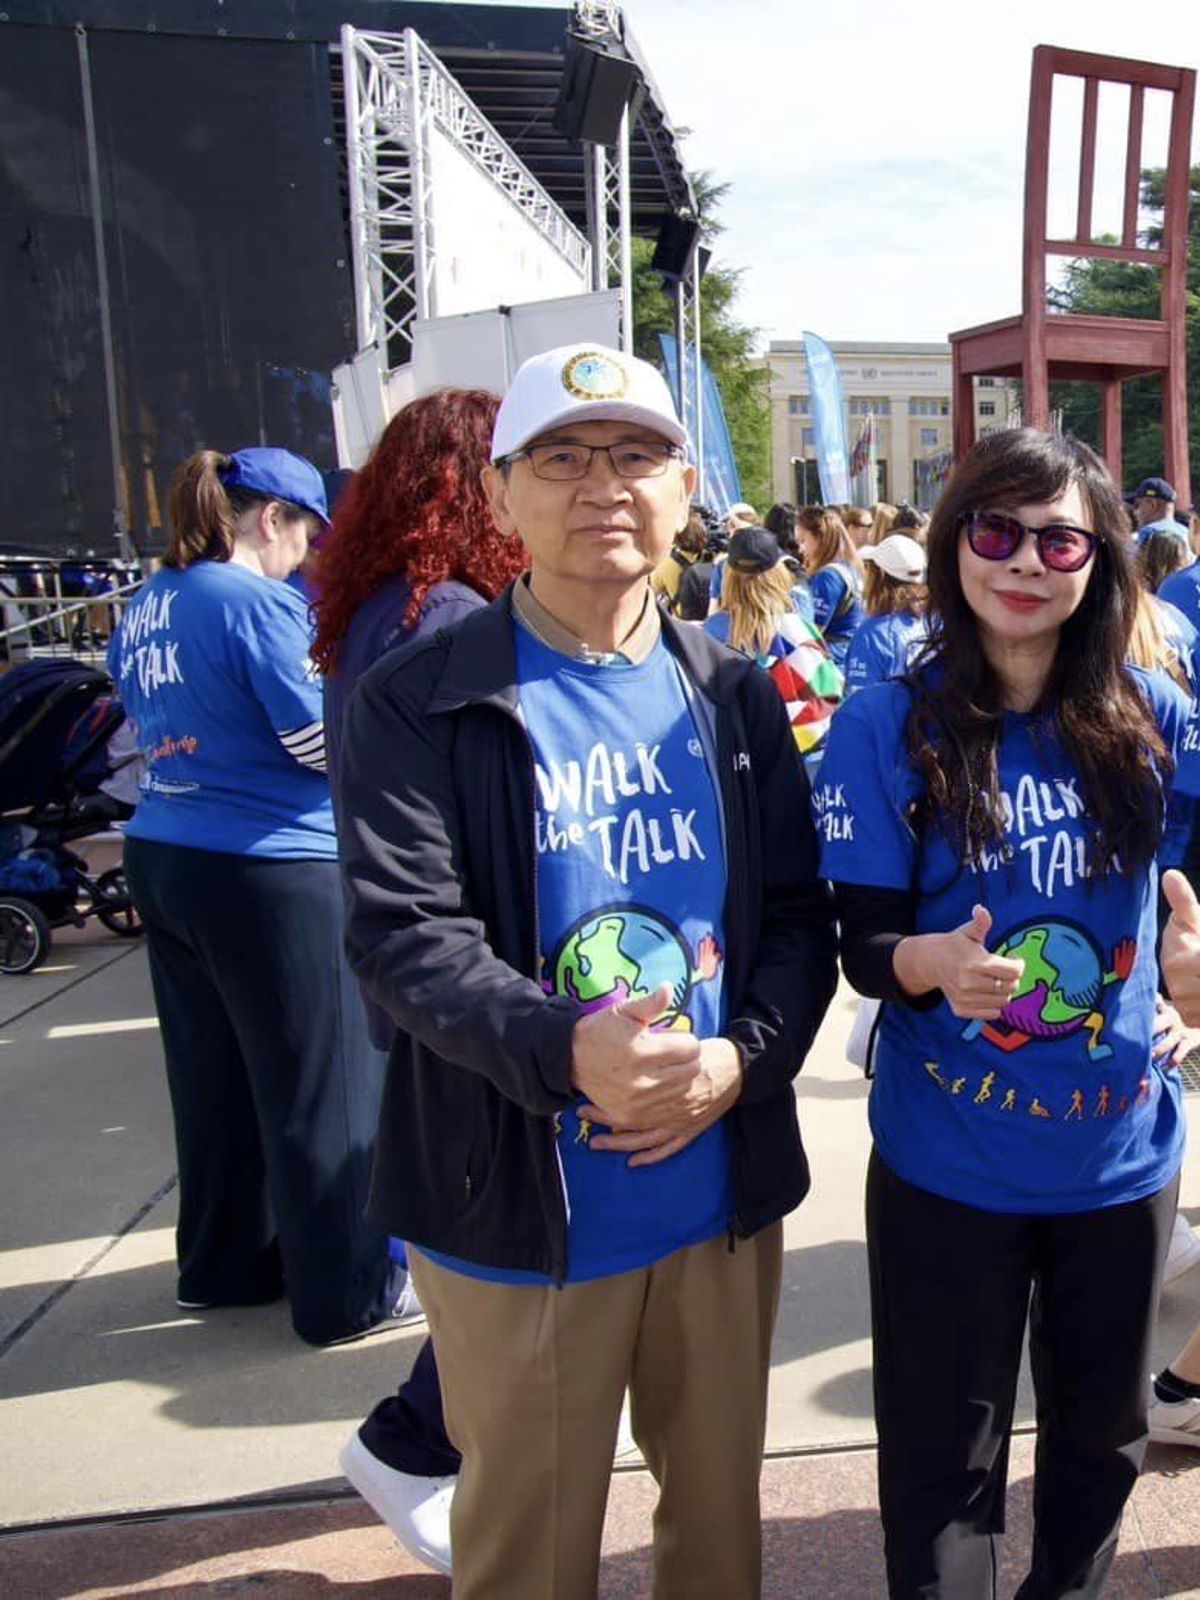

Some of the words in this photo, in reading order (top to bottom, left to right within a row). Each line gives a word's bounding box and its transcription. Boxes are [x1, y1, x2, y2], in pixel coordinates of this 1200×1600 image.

[121, 589, 178, 648] WALK
[135, 641, 184, 698] TALK
[536, 742, 672, 816] WALK
[535, 811, 584, 853] the
[588, 808, 706, 884] TALK
[1020, 831, 1123, 898] TAL
